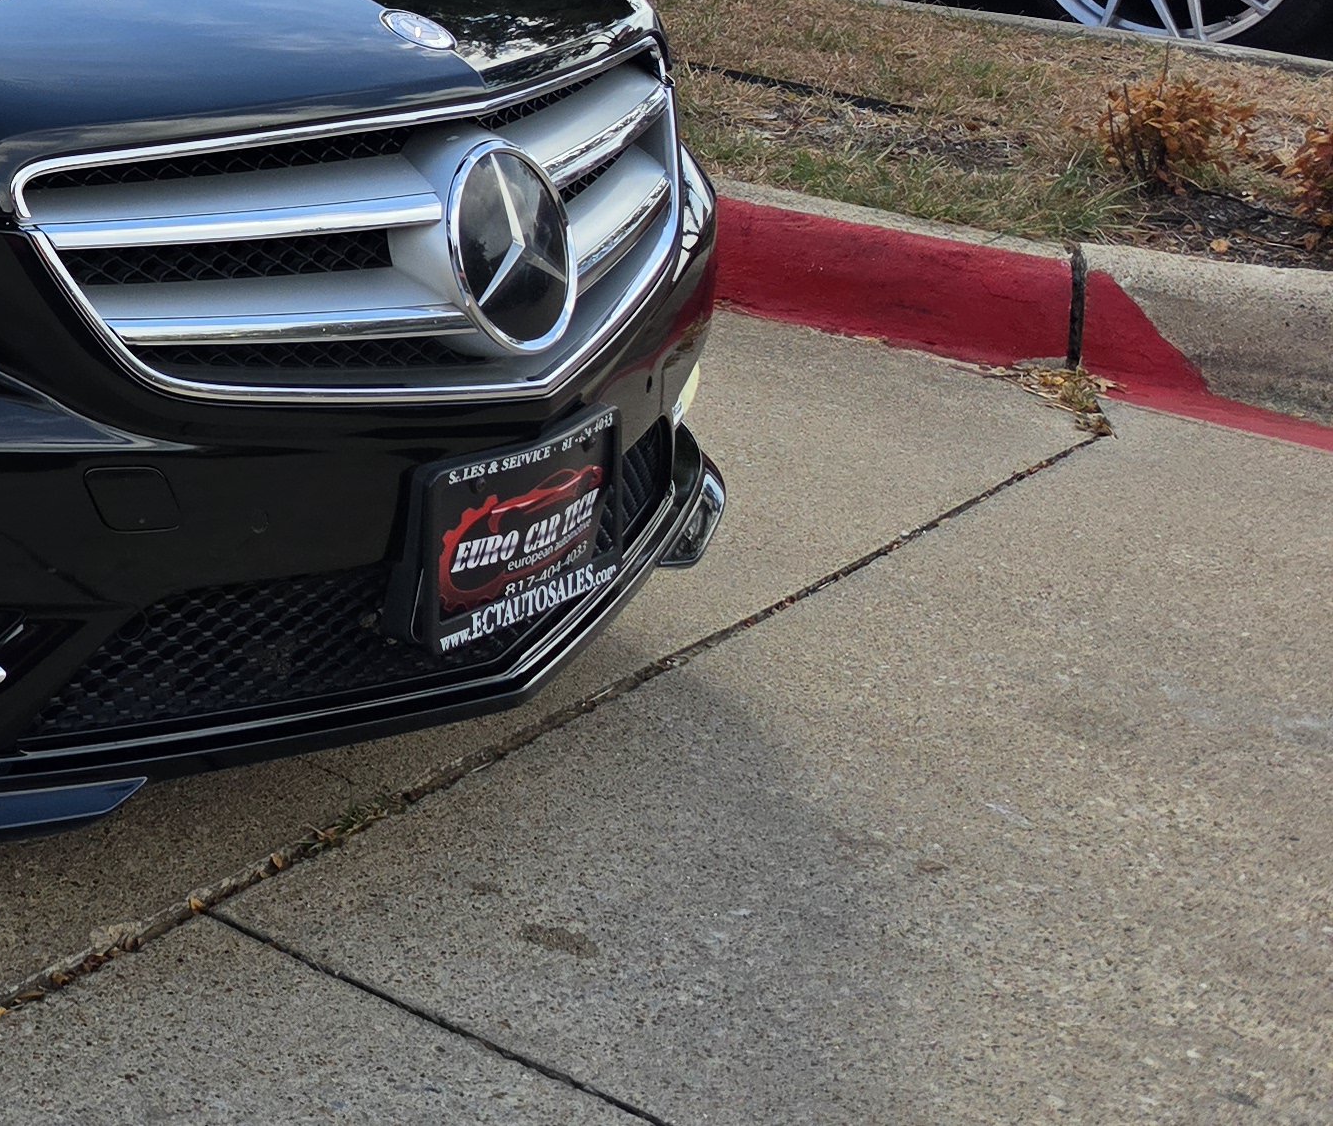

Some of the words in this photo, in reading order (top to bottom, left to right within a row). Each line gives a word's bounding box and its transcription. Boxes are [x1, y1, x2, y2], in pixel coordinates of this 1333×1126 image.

[487, 460, 498, 475] &
[450, 529, 520, 574] EURO
[523, 514, 561, 555] CAR
[562, 487, 599, 536] TECH
[507, 544, 554, 572] european
[504, 540, 589, 597] 817-404-4033
[439, 562, 617, 652] www.ECTAUTOSALES.com
